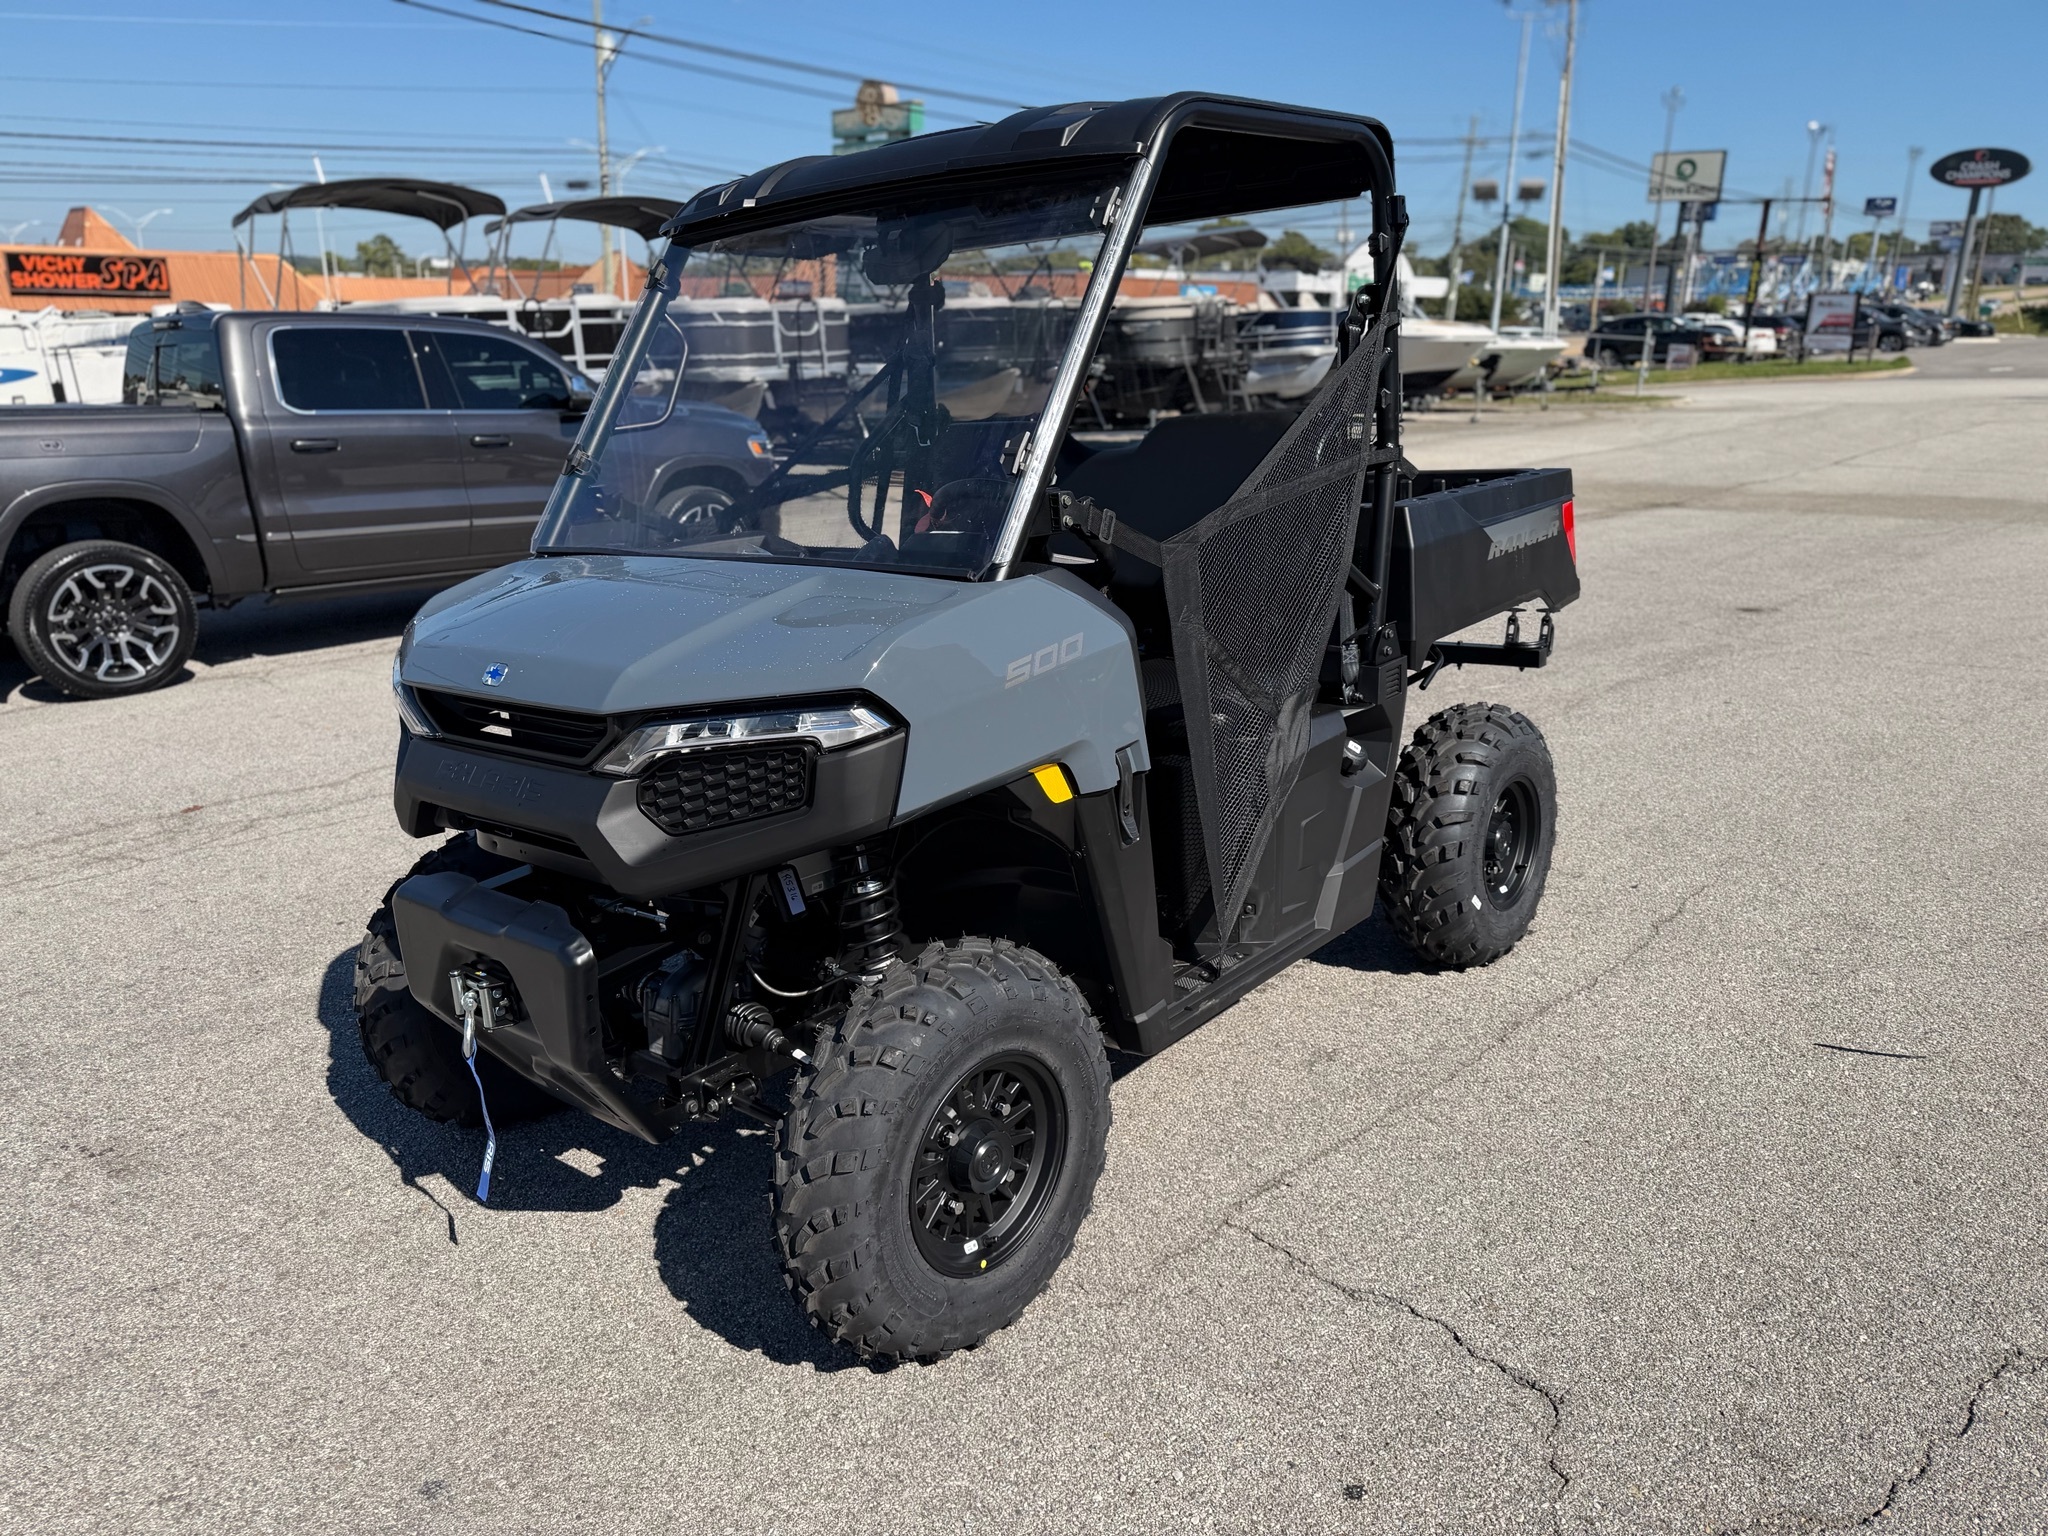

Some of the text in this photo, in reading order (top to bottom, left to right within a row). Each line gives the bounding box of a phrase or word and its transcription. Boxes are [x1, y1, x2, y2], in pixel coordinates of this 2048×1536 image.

[10, 270, 101, 289] SHOWER
[19, 254, 86, 272] VICHY
[100, 256, 169, 291] SPA
[1487, 519, 1560, 561] RANGER
[1004, 632, 1084, 690] 500
[434, 759, 546, 802] POLARIS
[906, 1014, 999, 1114] CARLSTAR
